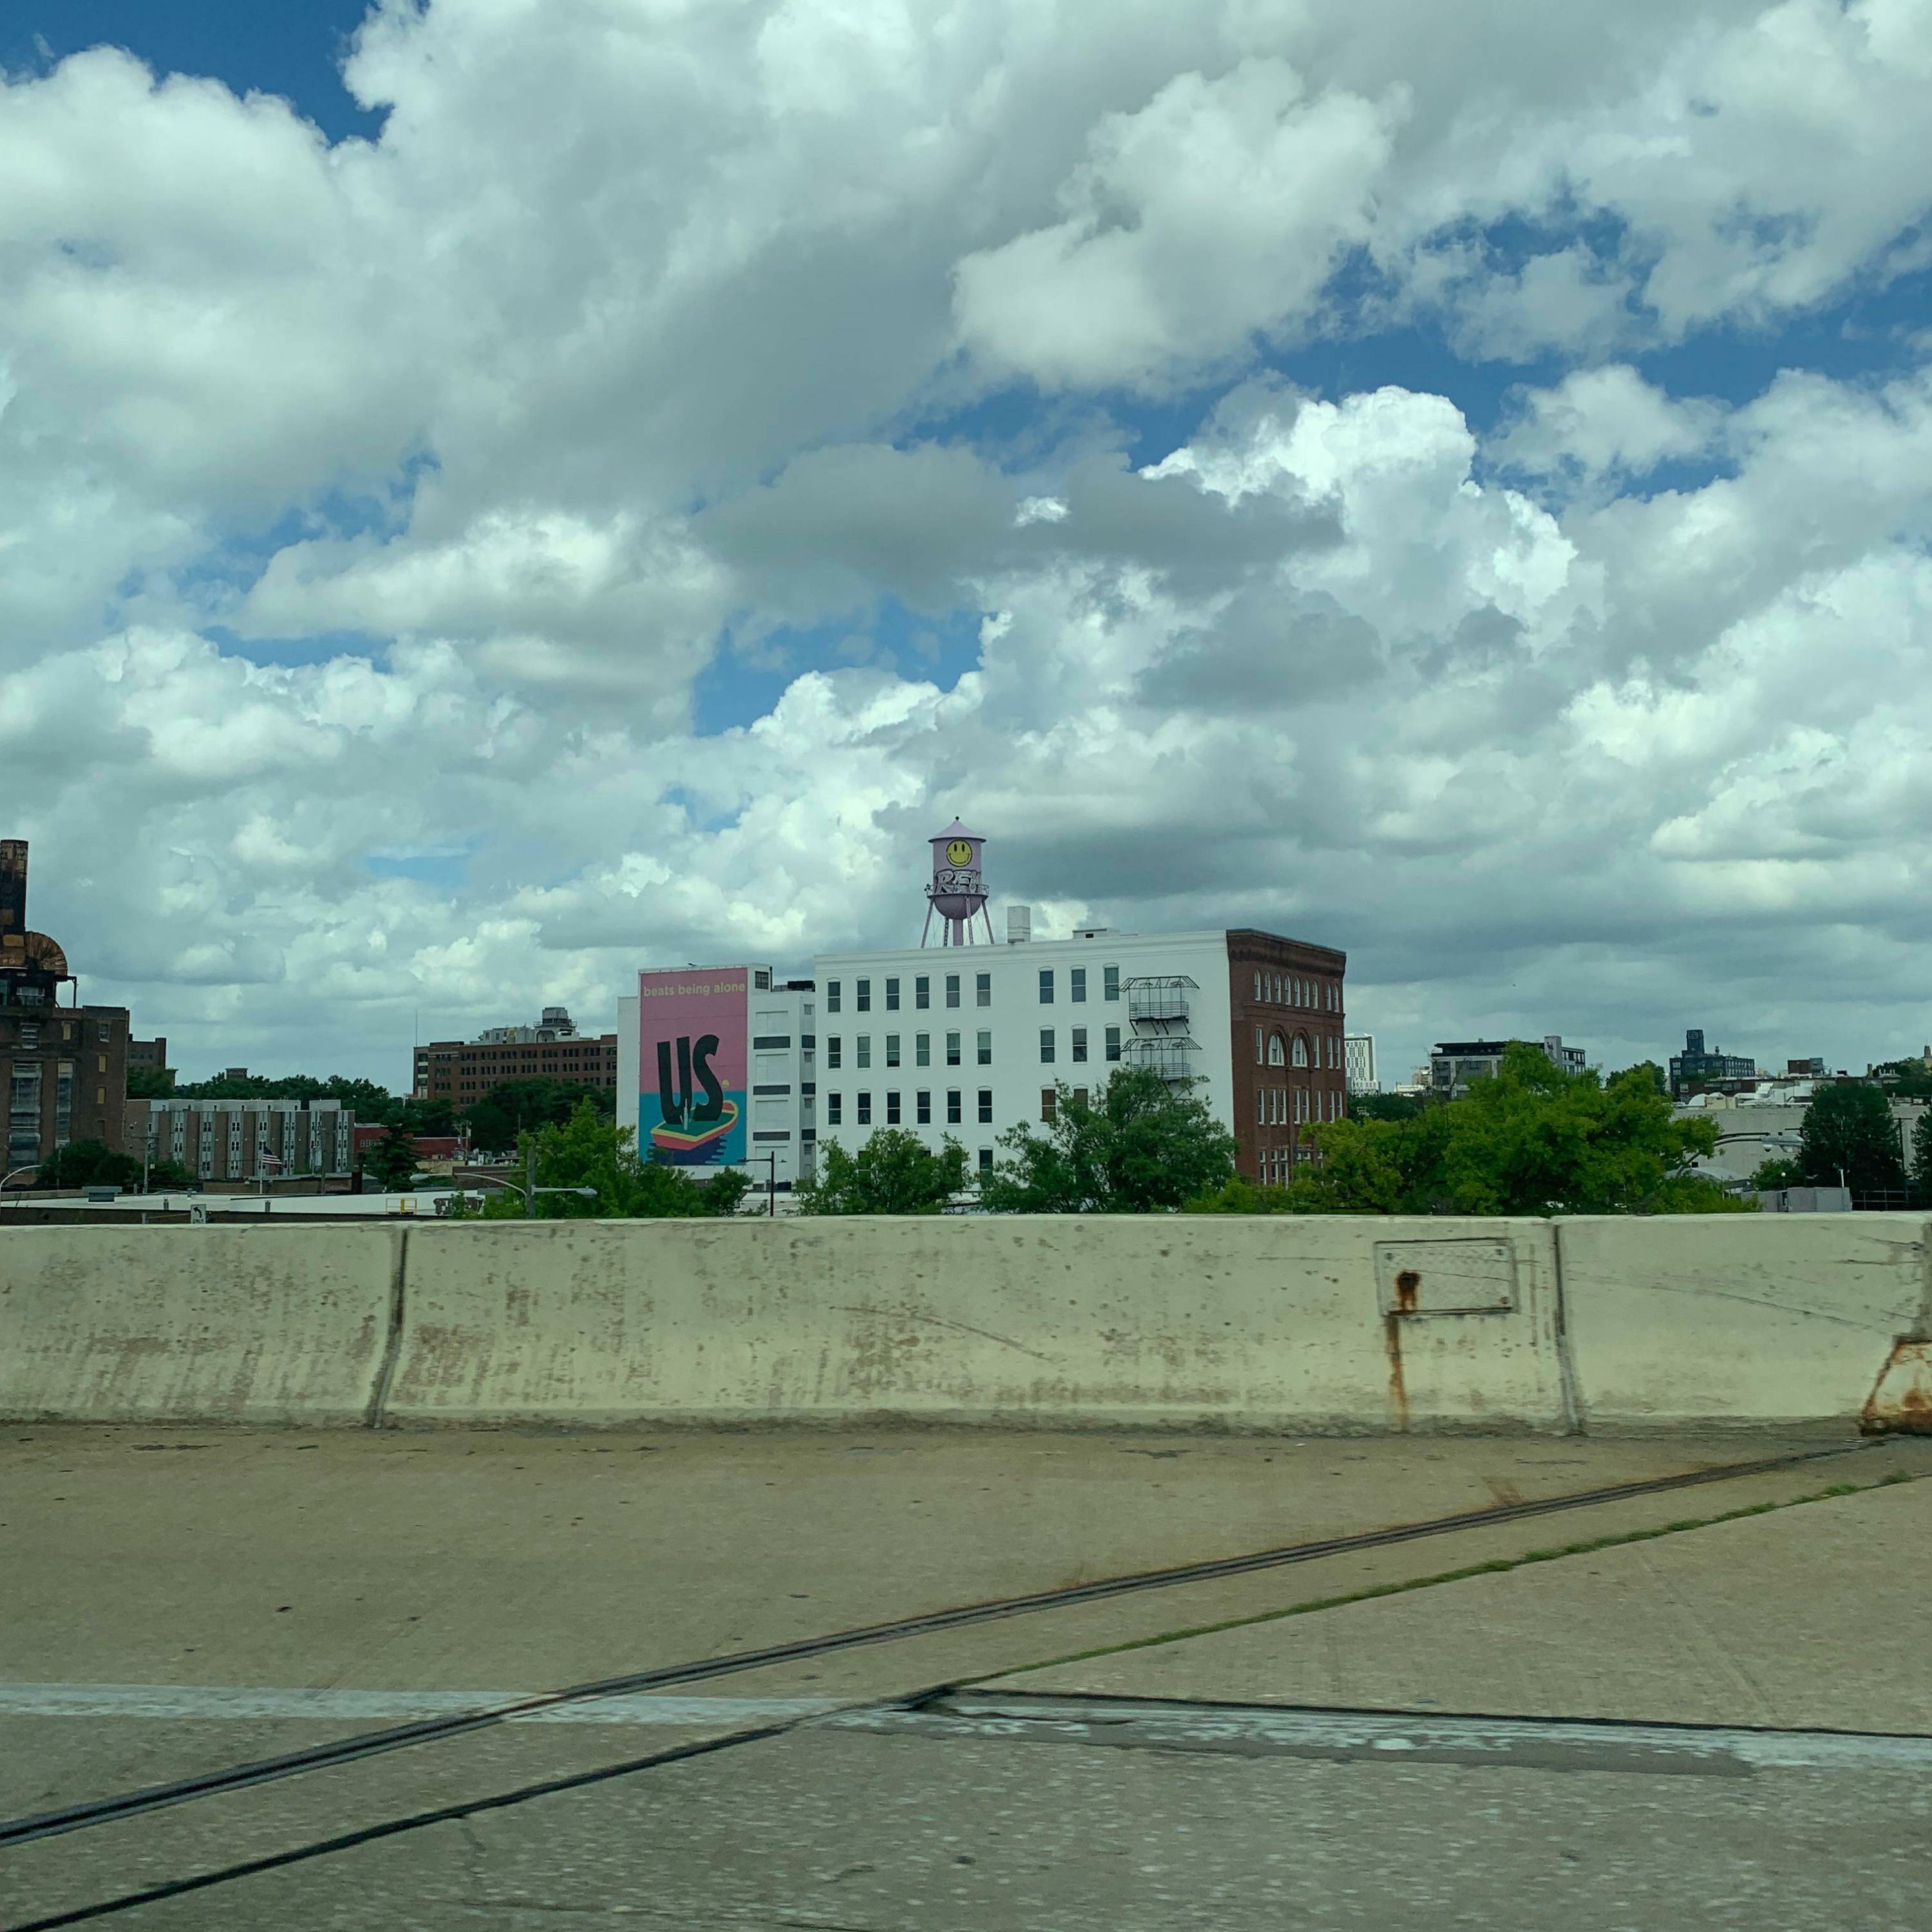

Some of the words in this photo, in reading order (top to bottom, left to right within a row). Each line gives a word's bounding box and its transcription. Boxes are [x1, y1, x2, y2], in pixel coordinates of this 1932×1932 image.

[644, 985, 674, 996] beats
[678, 983, 710, 995] being
[714, 982, 746, 993] alone
[657, 1034, 723, 1124] US
